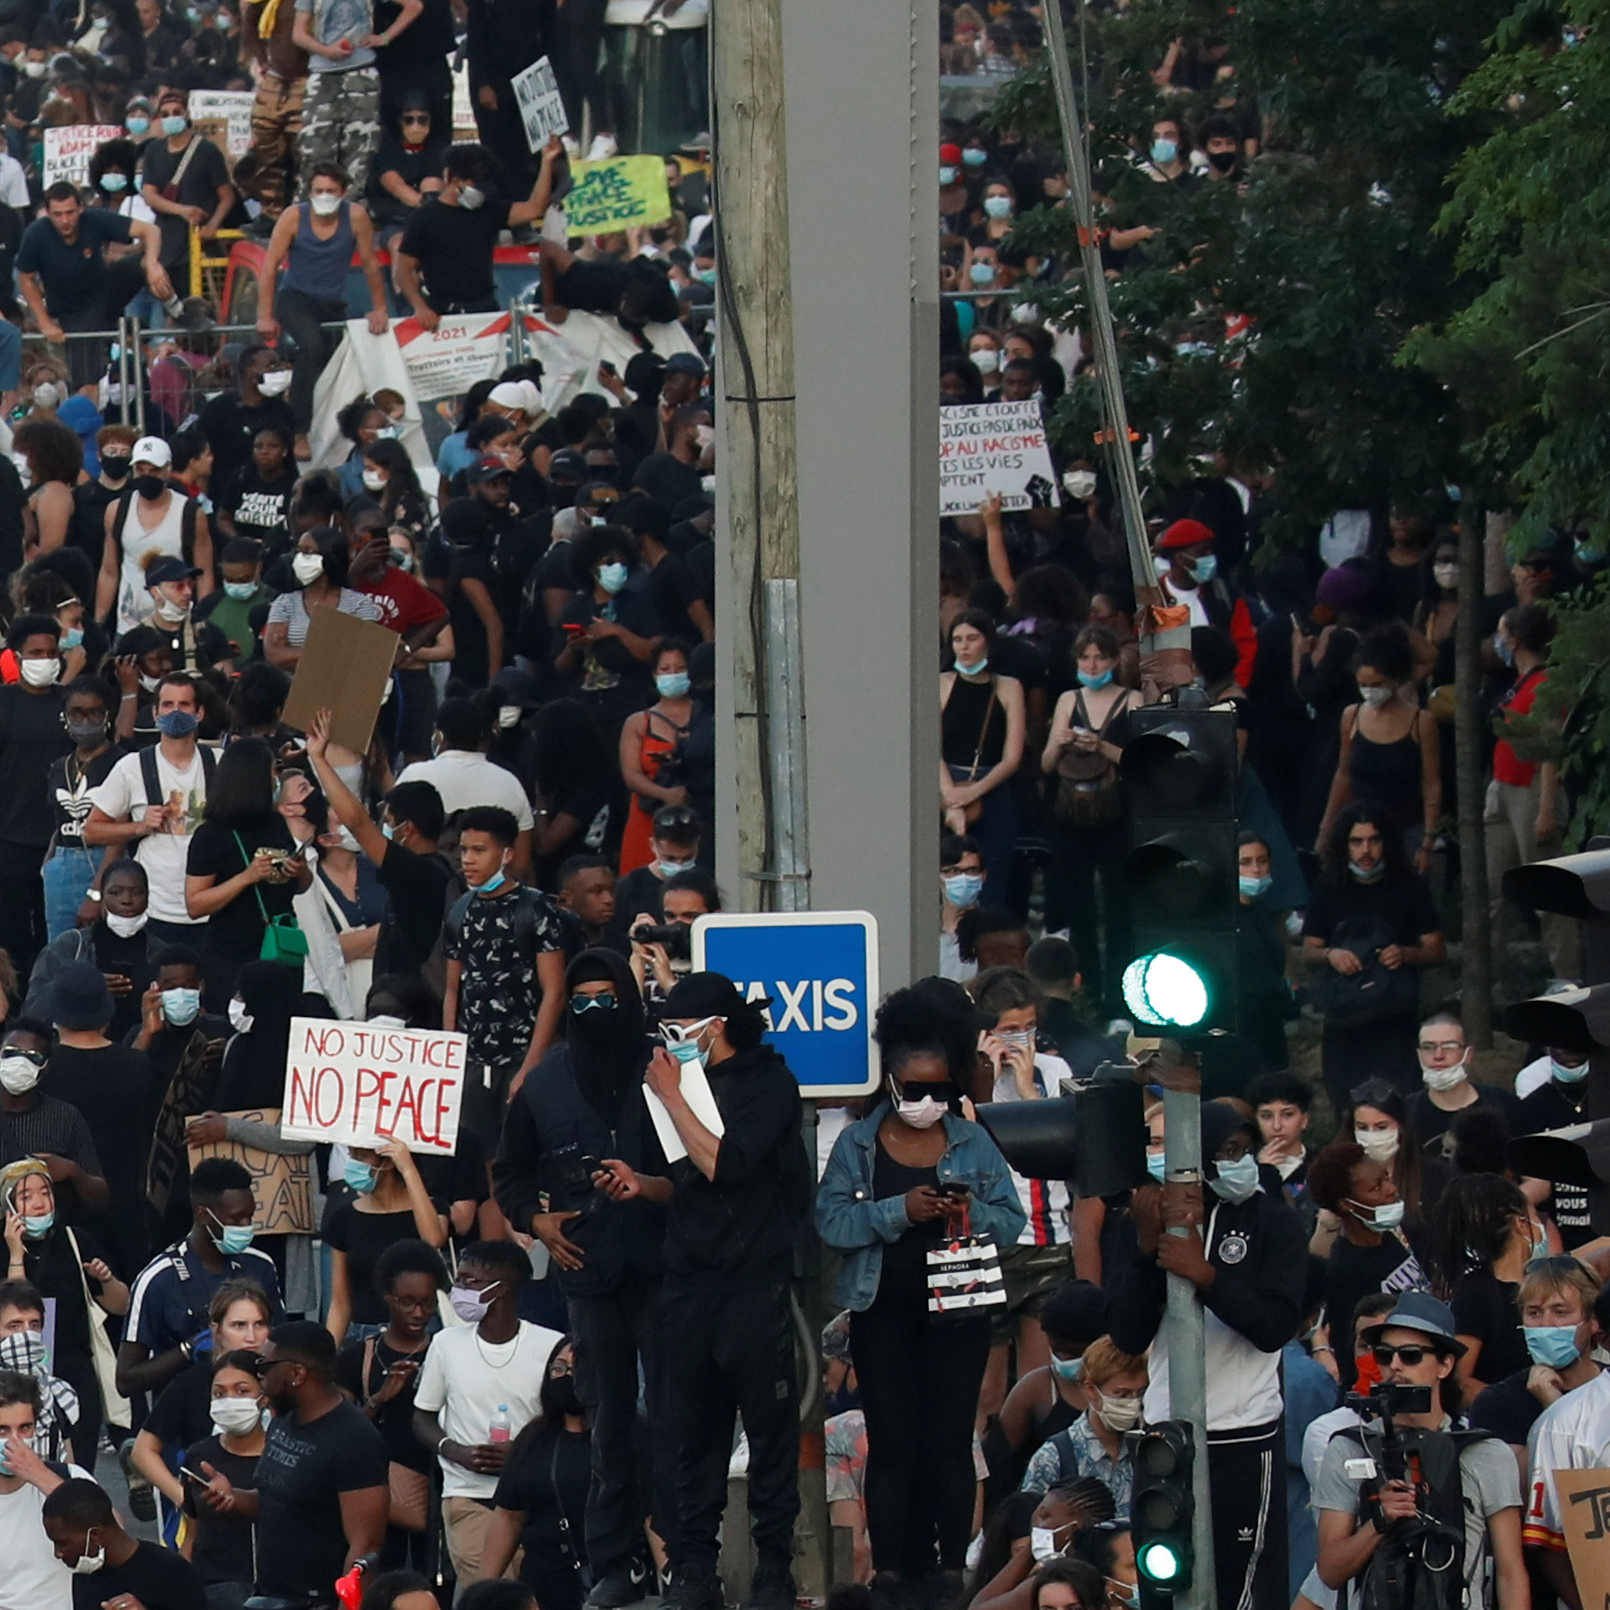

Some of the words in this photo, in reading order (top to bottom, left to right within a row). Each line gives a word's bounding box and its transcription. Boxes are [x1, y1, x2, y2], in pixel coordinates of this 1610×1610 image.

[433, 326, 468, 342] 2021
[957, 439, 978, 456] AU
[982, 433, 1044, 453] RACISME
[961, 457, 985, 471] LES
[240, 490, 283, 507] VÉRITÉ
[241, 502, 279, 515] POUR
[736, 978, 859, 1033] AXIS
[305, 1027, 345, 1058] NO
[353, 1032, 463, 1069] JUSTICE
[289, 1066, 345, 1128] NO
[352, 1068, 457, 1149] PEACE
[1556, 1212, 1592, 1229] jamai
